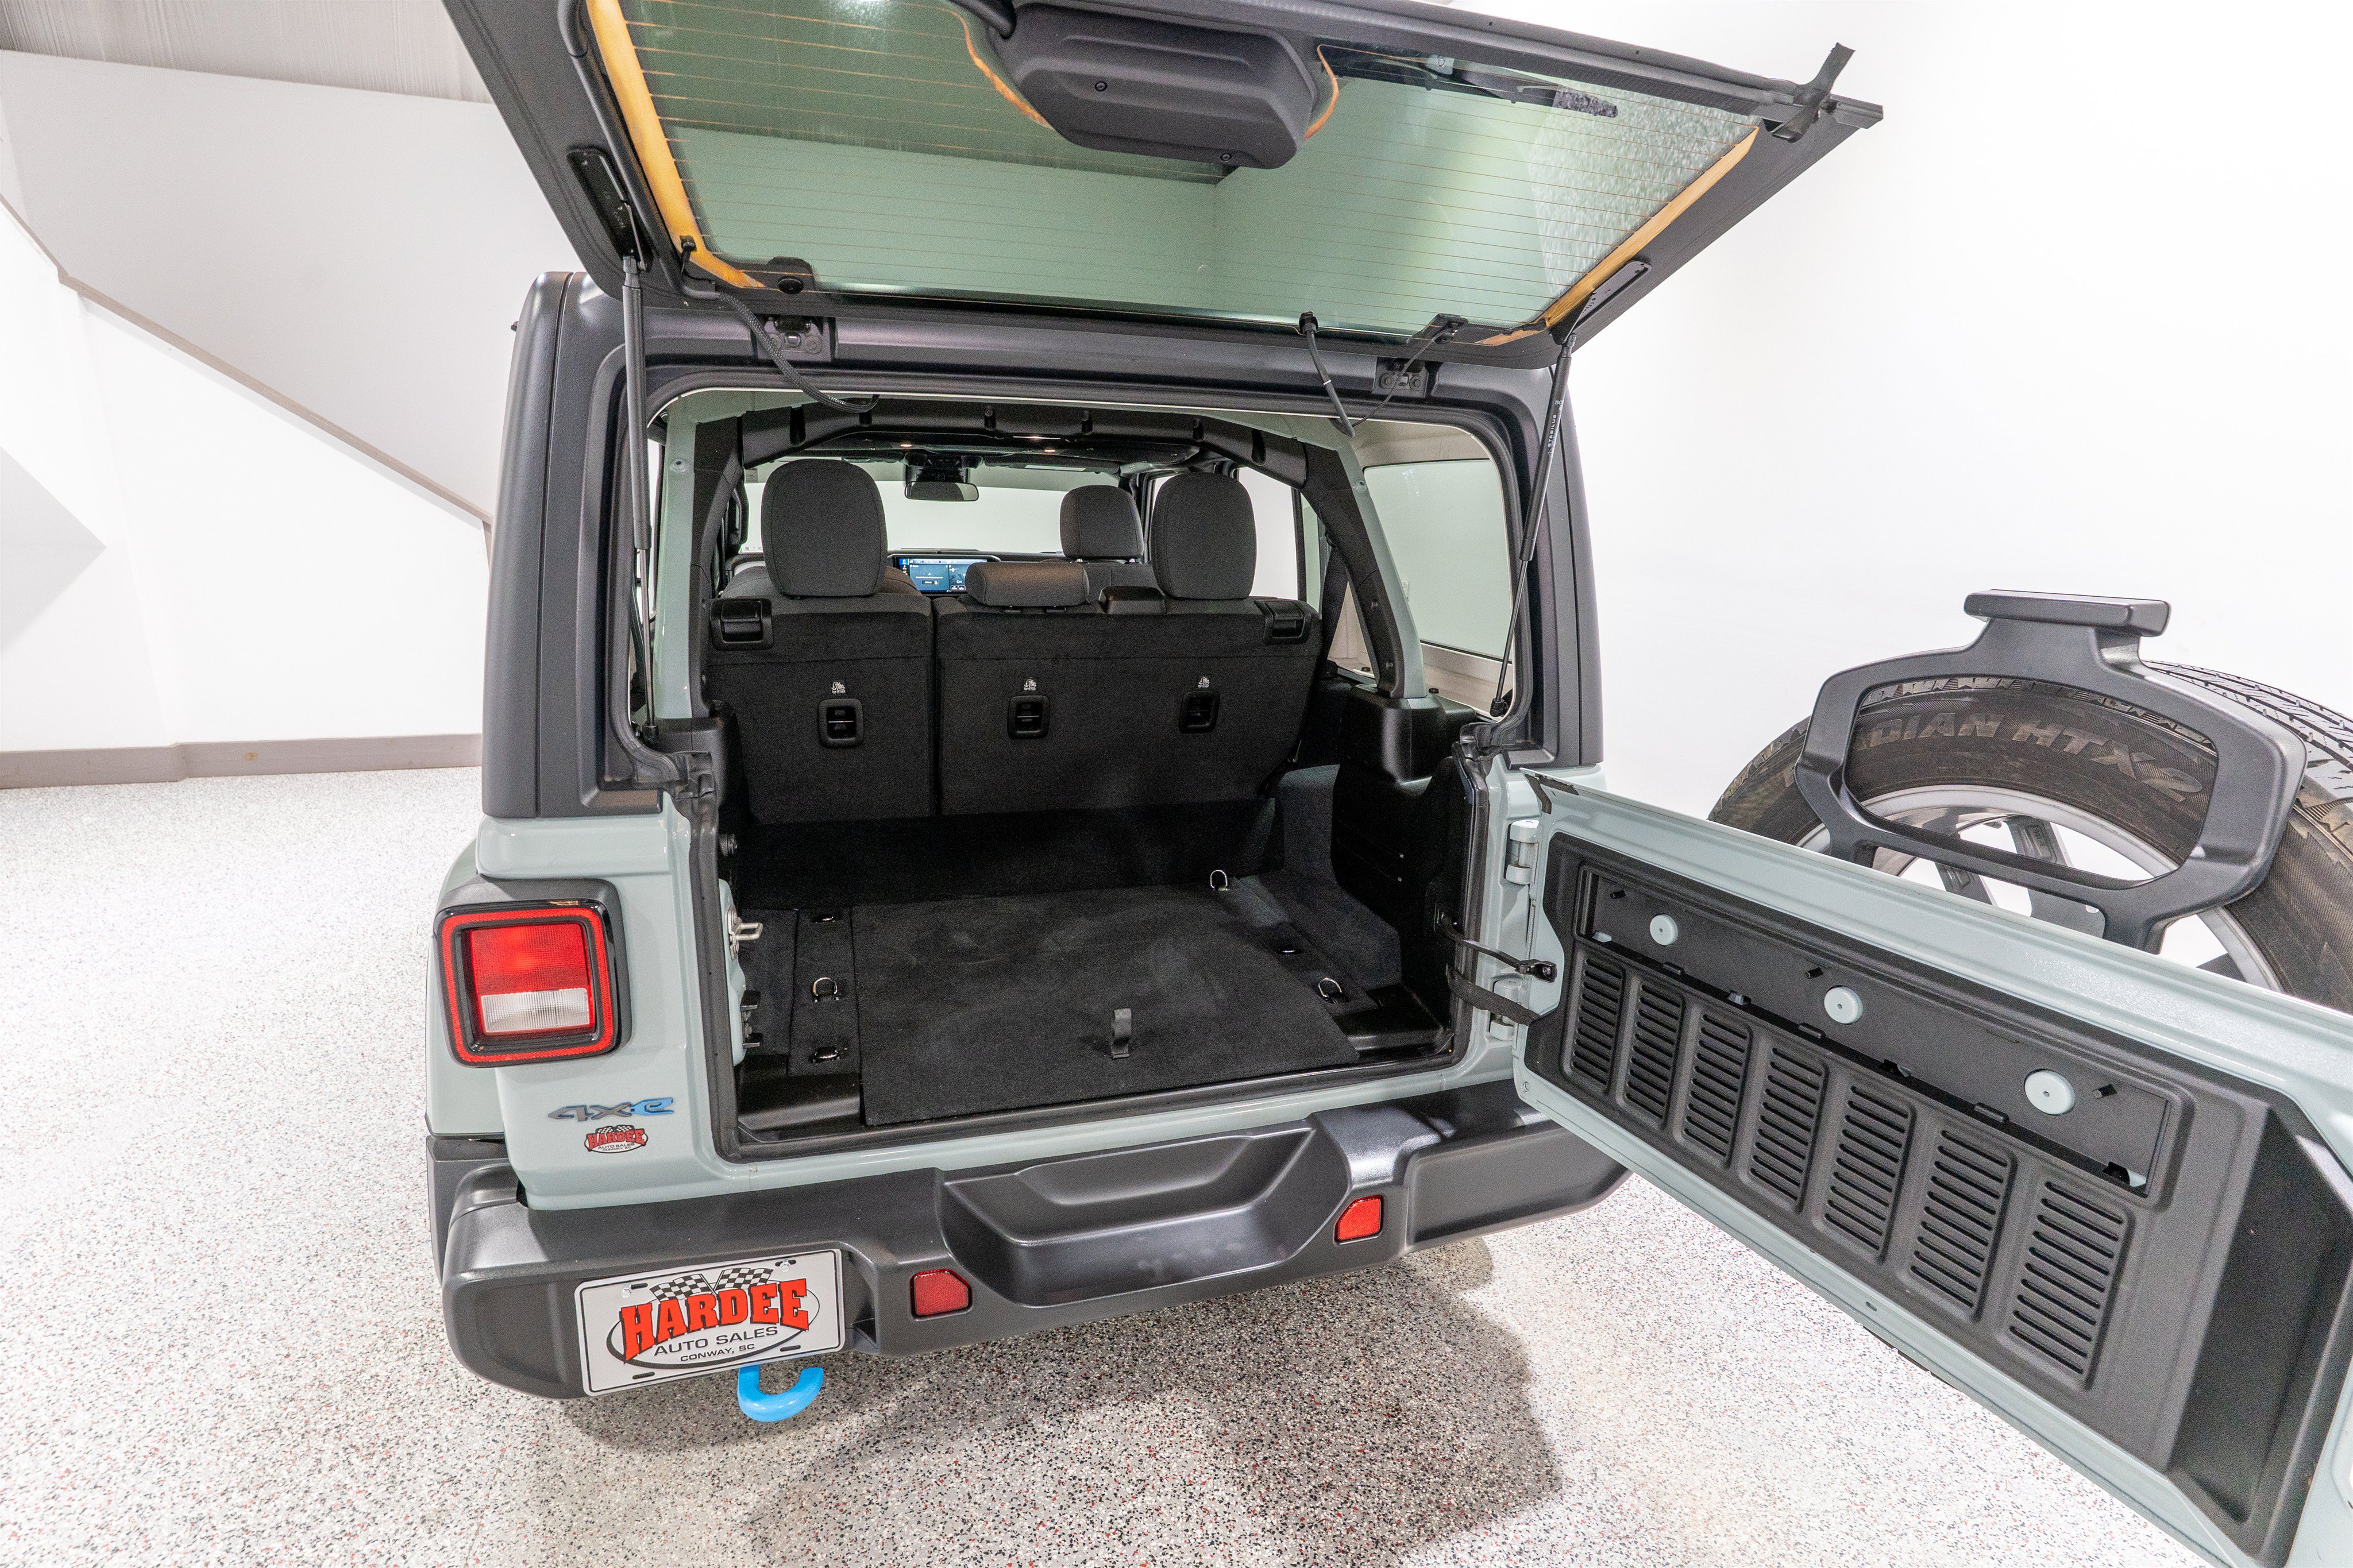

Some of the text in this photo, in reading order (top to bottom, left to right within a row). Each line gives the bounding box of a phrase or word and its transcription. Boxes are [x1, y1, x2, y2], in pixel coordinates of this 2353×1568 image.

[1547, 414, 1557, 447] STABILUS
[587, 1129, 646, 1150] HARDEE
[619, 1278, 809, 1364] HARDEE
[654, 1326, 778, 1356] AUTO SALES
[680, 1343, 755, 1362] CONWAY, SC
